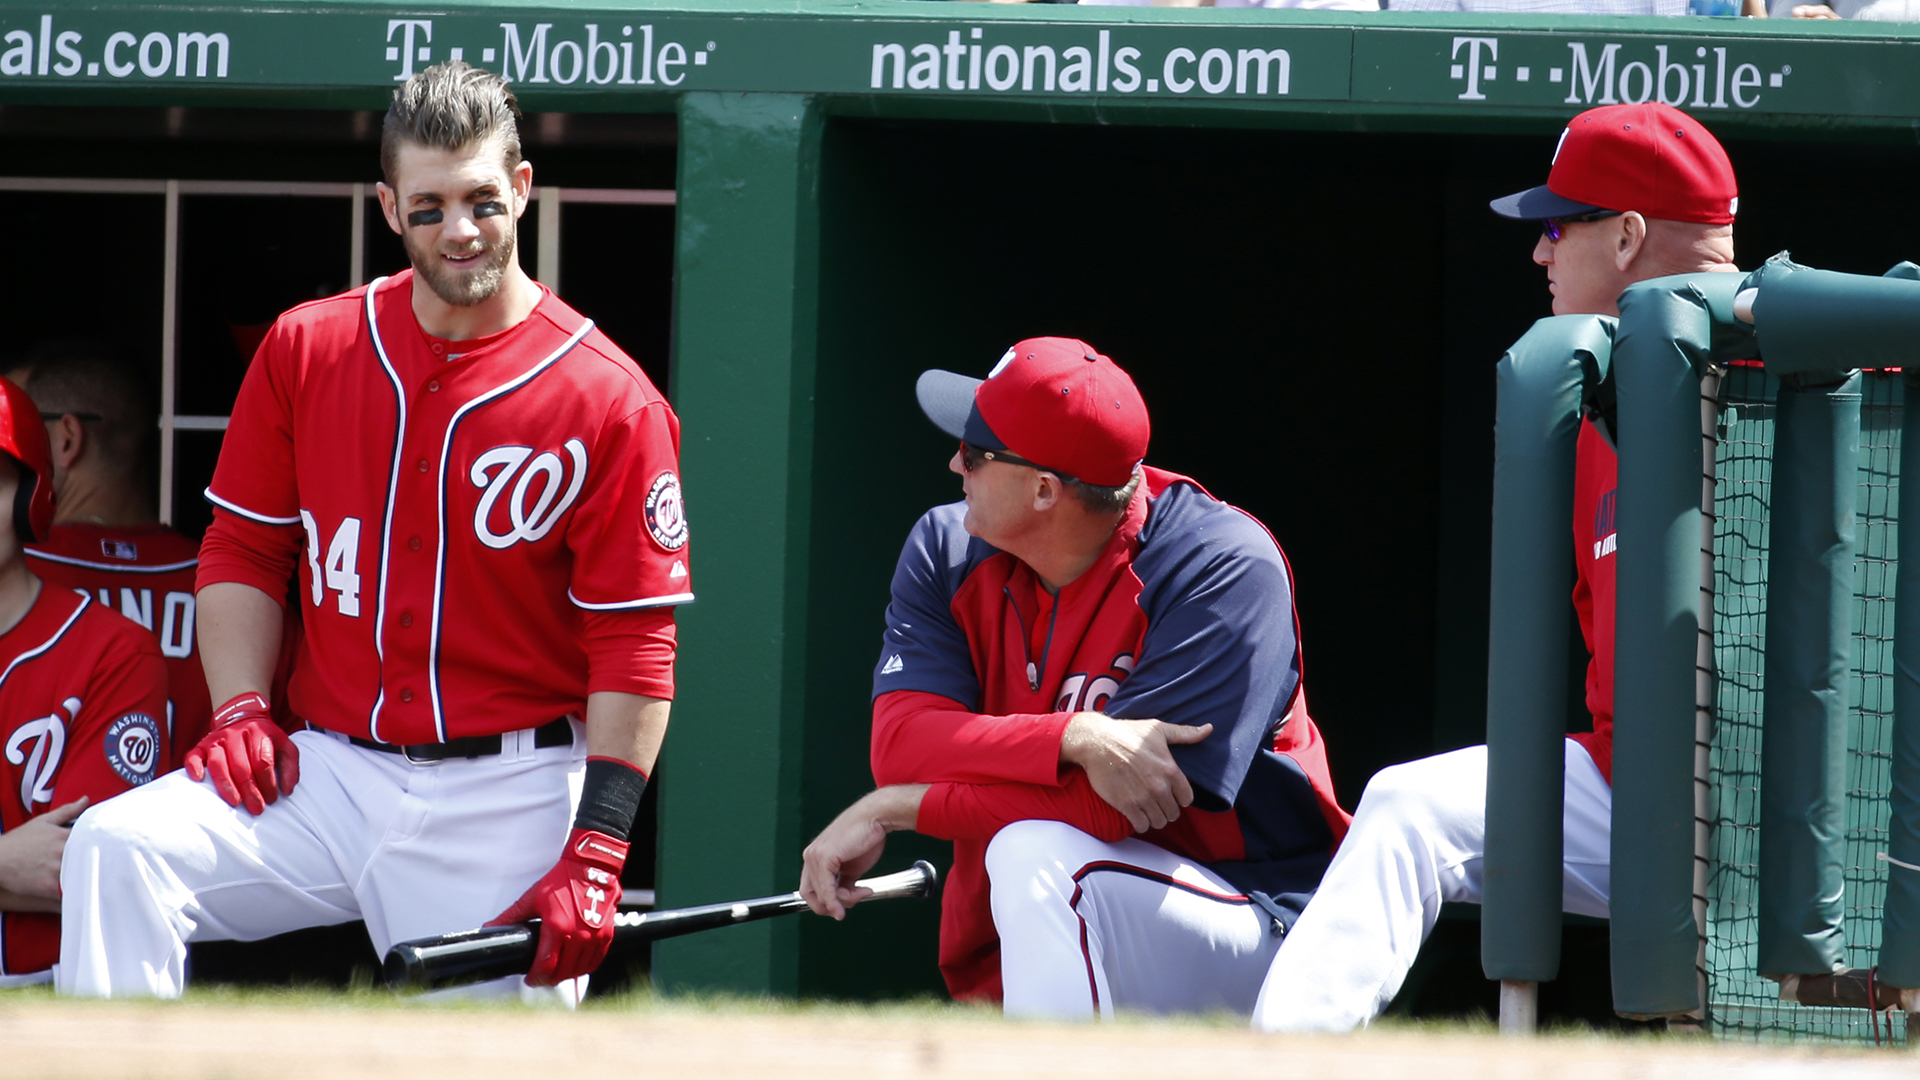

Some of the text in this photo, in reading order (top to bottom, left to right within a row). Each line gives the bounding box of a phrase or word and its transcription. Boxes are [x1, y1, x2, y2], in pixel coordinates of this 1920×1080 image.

[0, 15, 229, 78] als.com
[871, 28, 1291, 95] nationals.com
[470, 436, 588, 549] W
[646, 472, 681, 508] WASHIN
[300, 509, 361, 617] 34
[653, 519, 689, 549] NATIONA
[99, 588, 196, 659] NO
